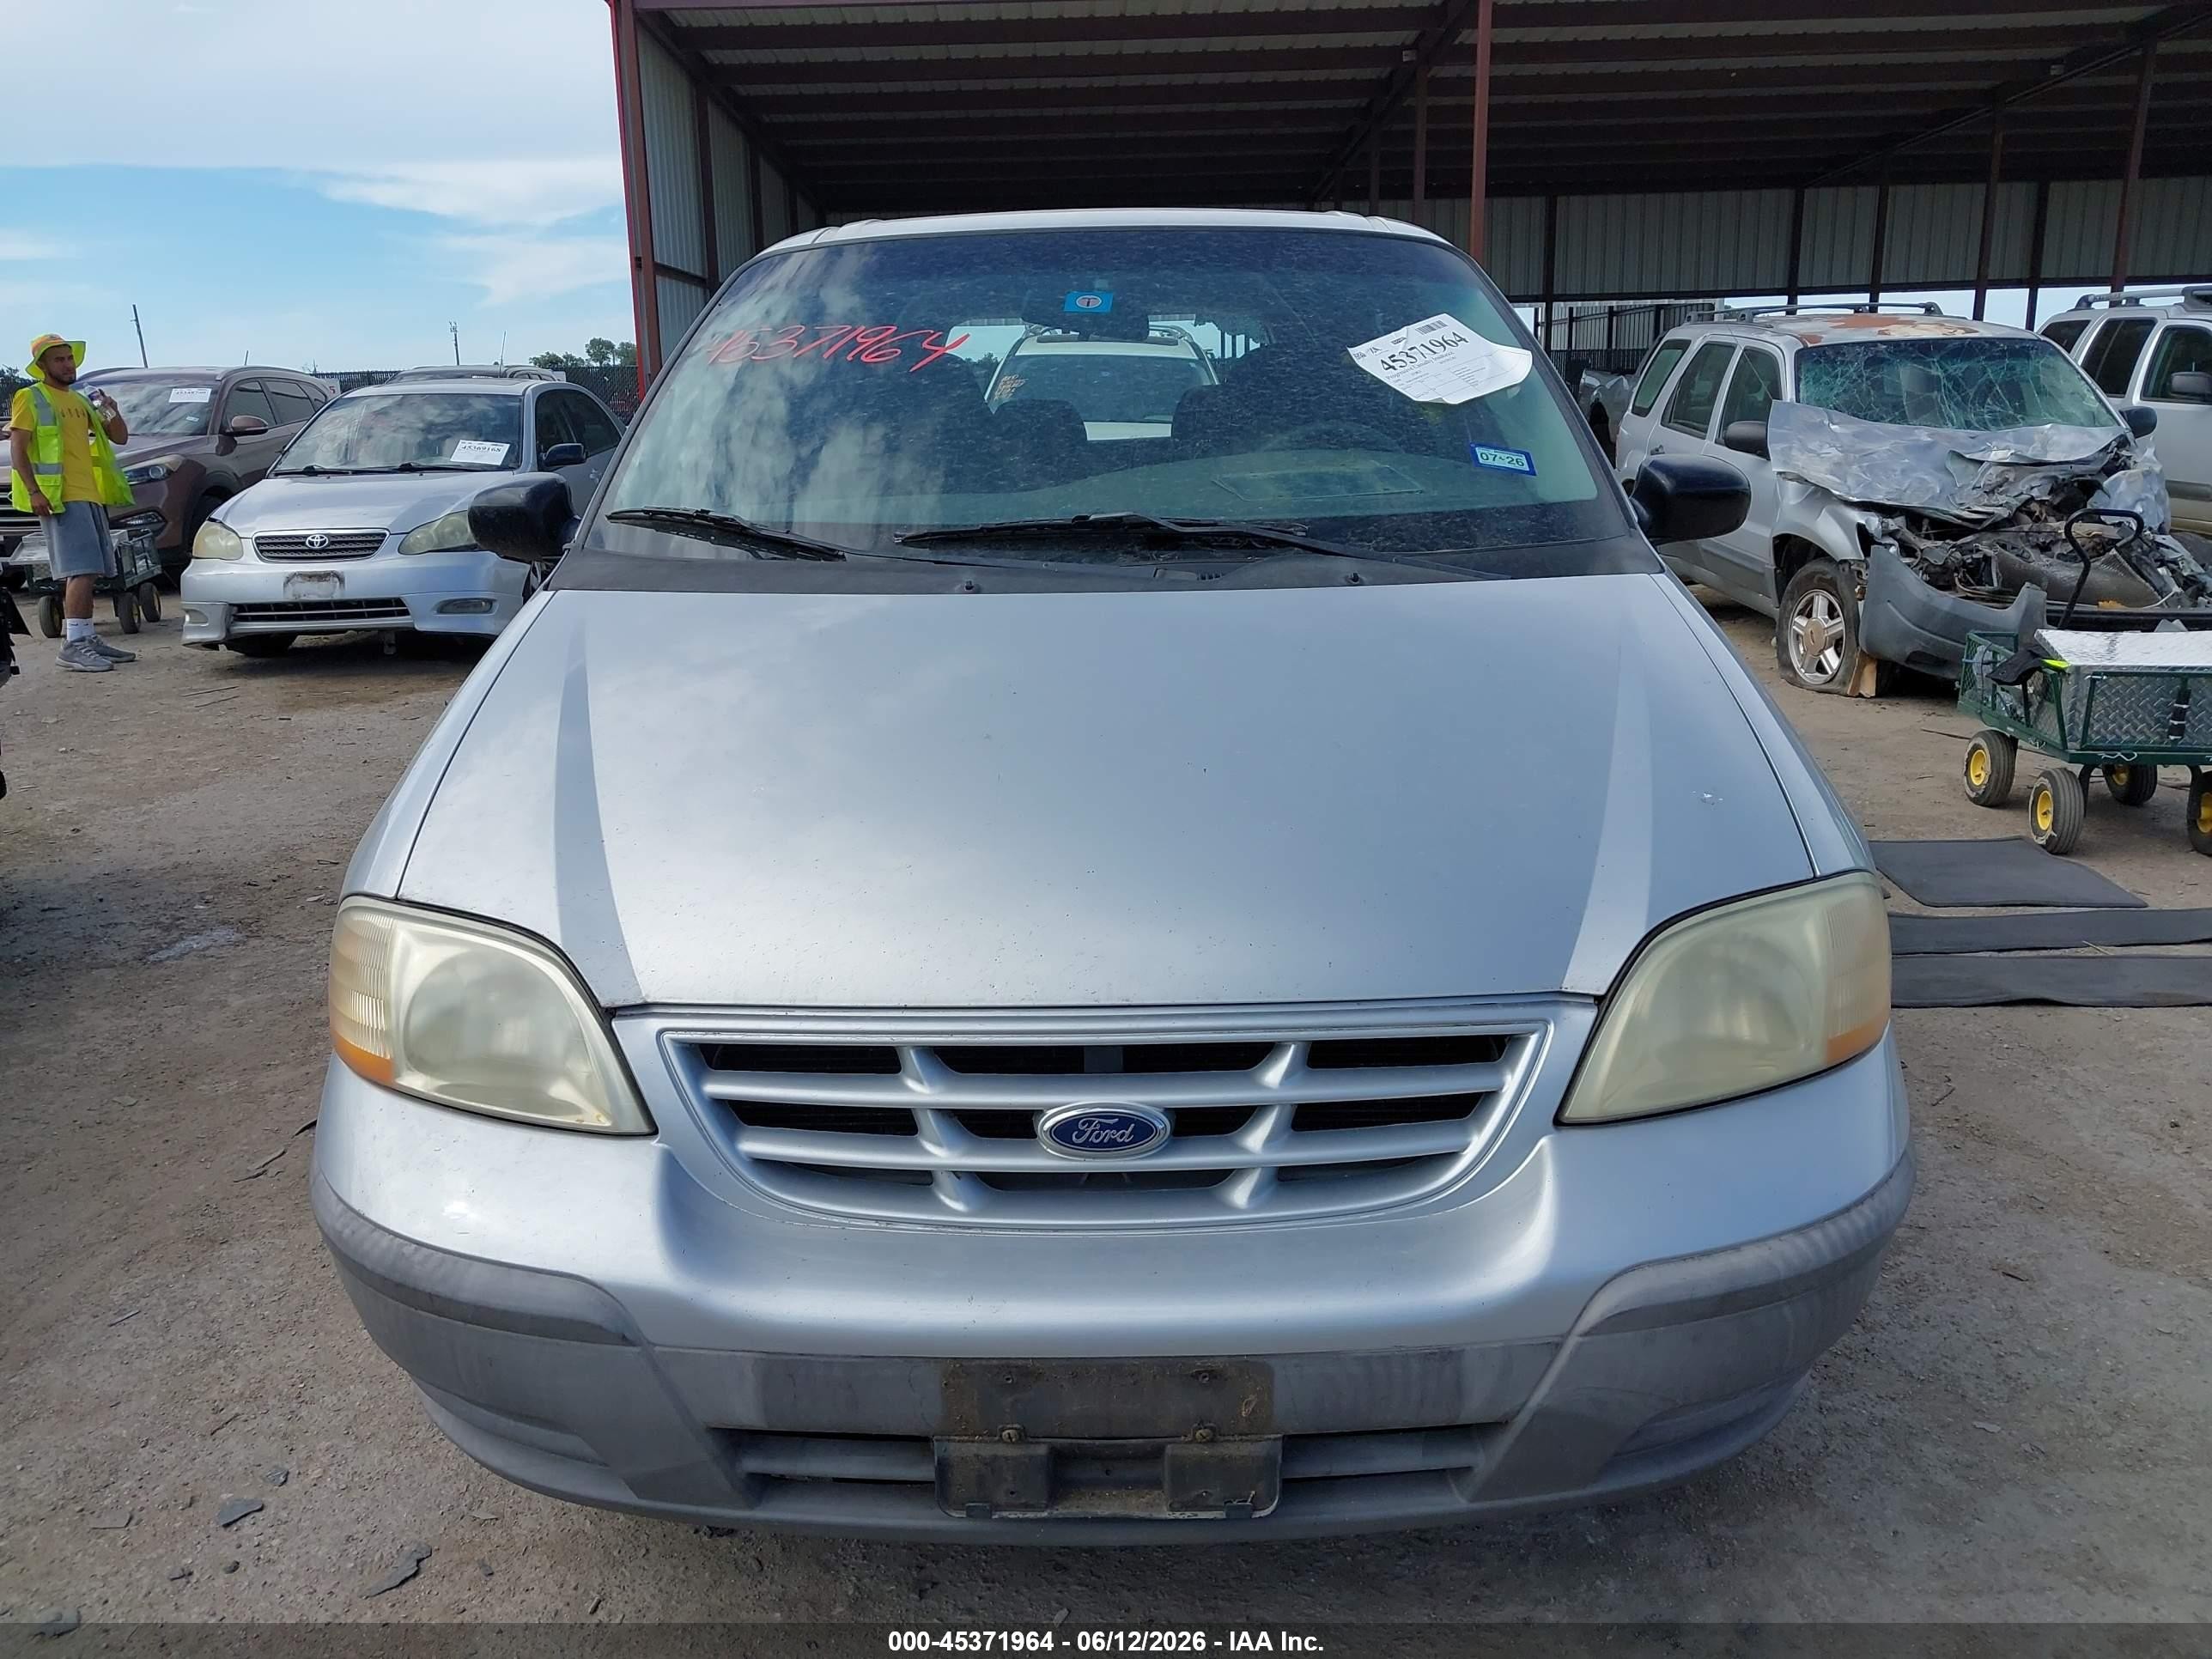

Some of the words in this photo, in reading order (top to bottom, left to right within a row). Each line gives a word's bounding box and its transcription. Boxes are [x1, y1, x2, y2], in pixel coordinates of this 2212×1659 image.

[1381, 331, 1469, 371] 45371964
[1480, 452, 1525, 466] 07-26
[1073, 1117, 1134, 1144] Ford
